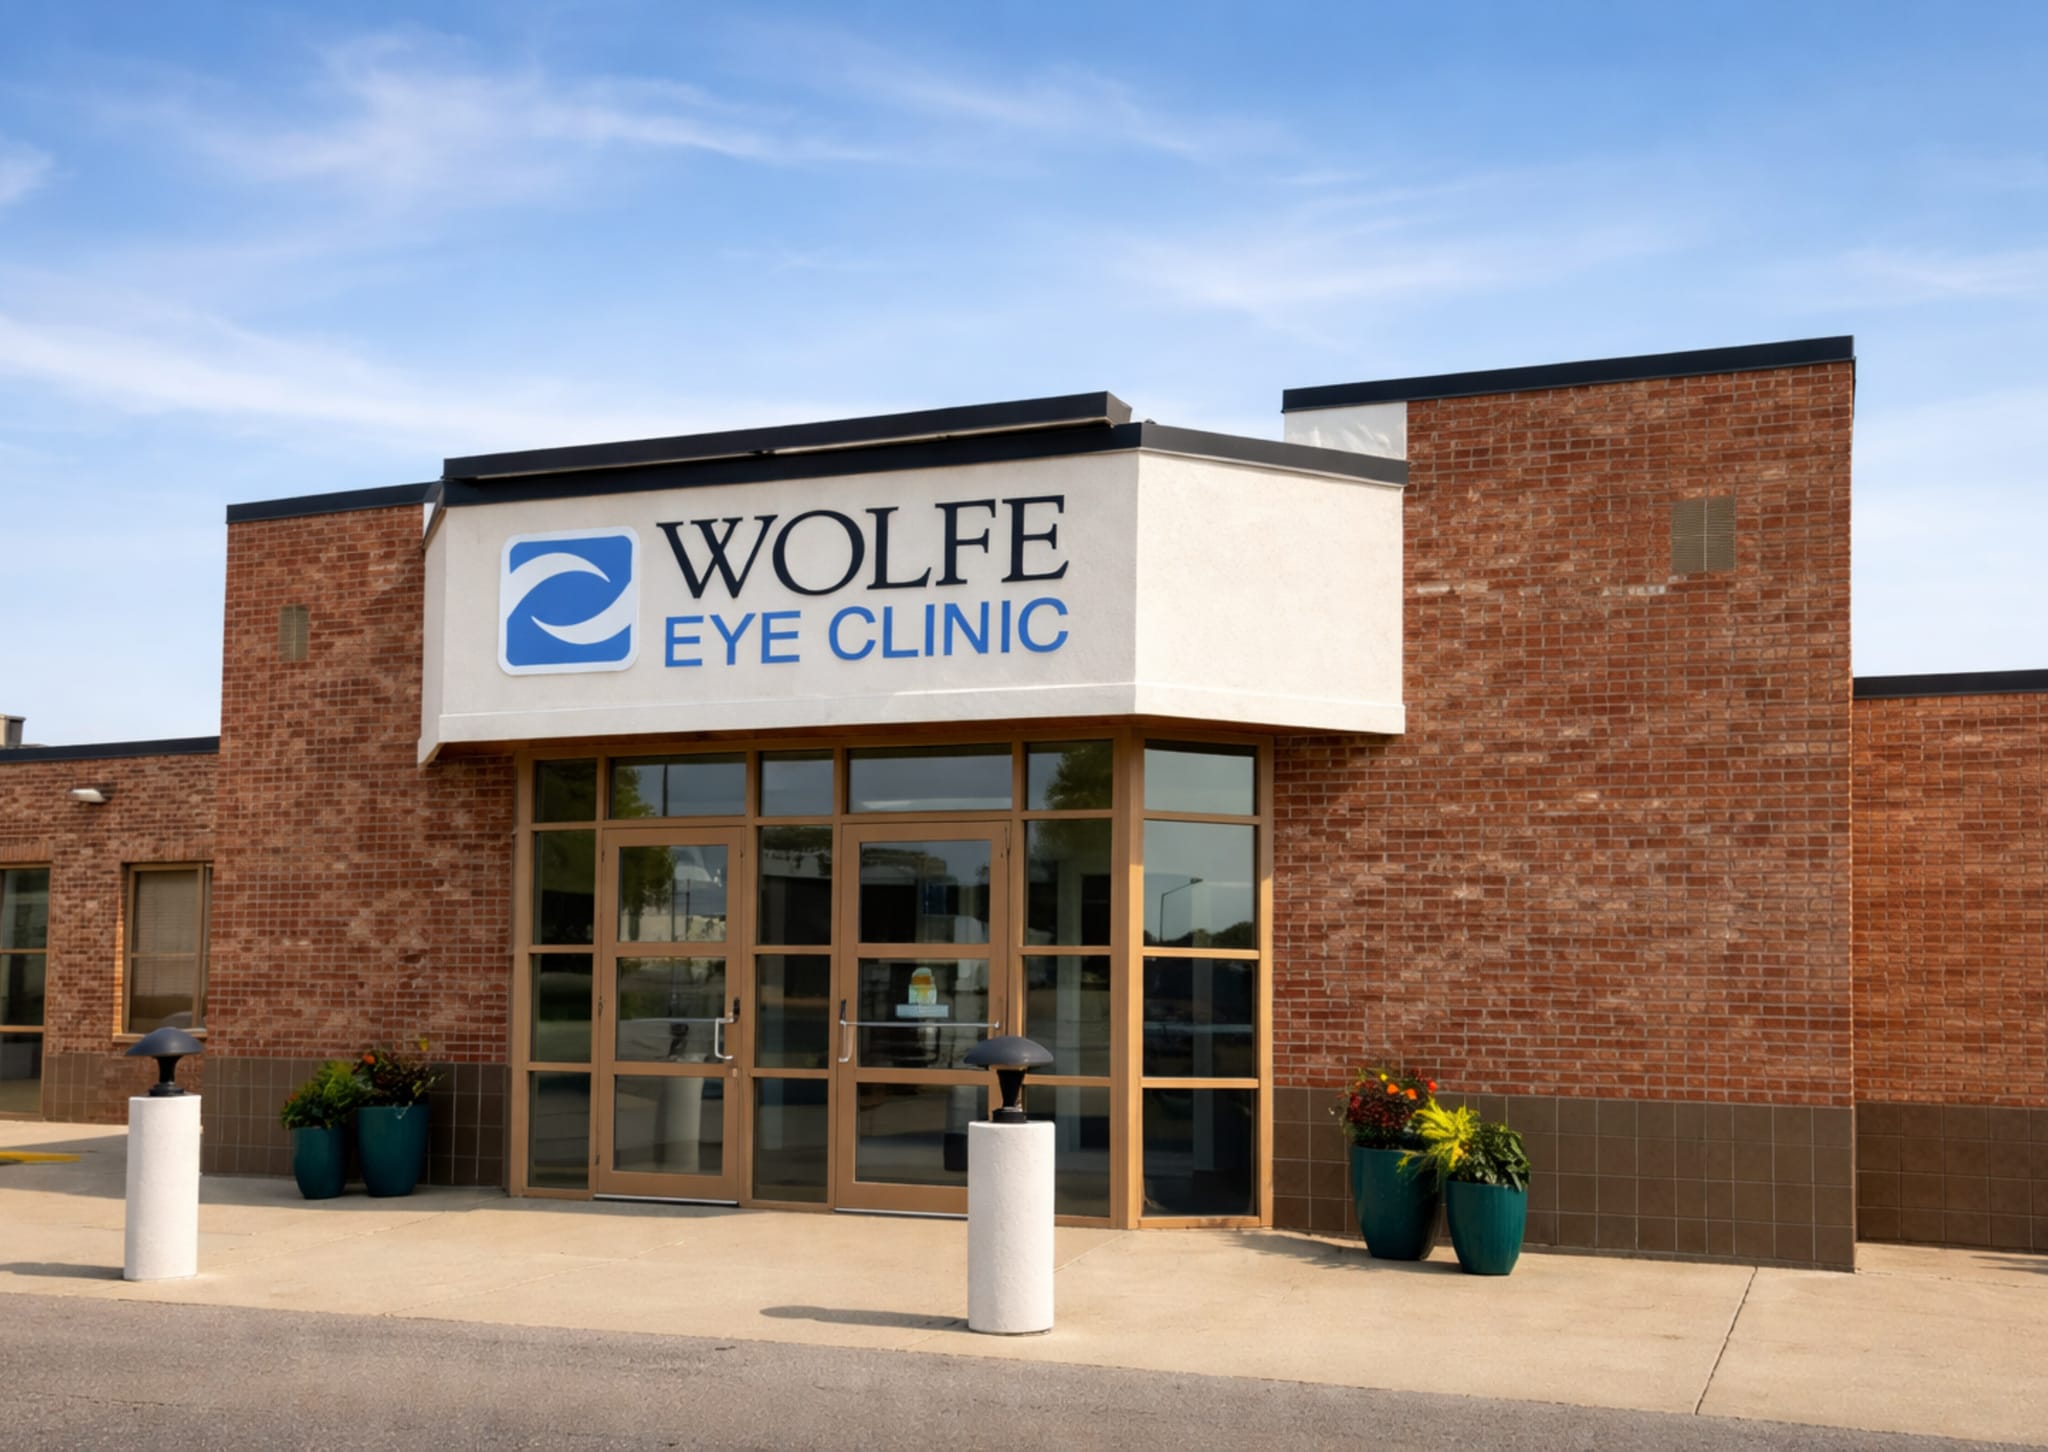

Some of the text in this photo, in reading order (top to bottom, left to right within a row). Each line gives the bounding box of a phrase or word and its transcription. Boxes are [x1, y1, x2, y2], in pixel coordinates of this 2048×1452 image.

[655, 494, 1070, 600] WOLFE
[664, 597, 1070, 668] EYE CLINIC
